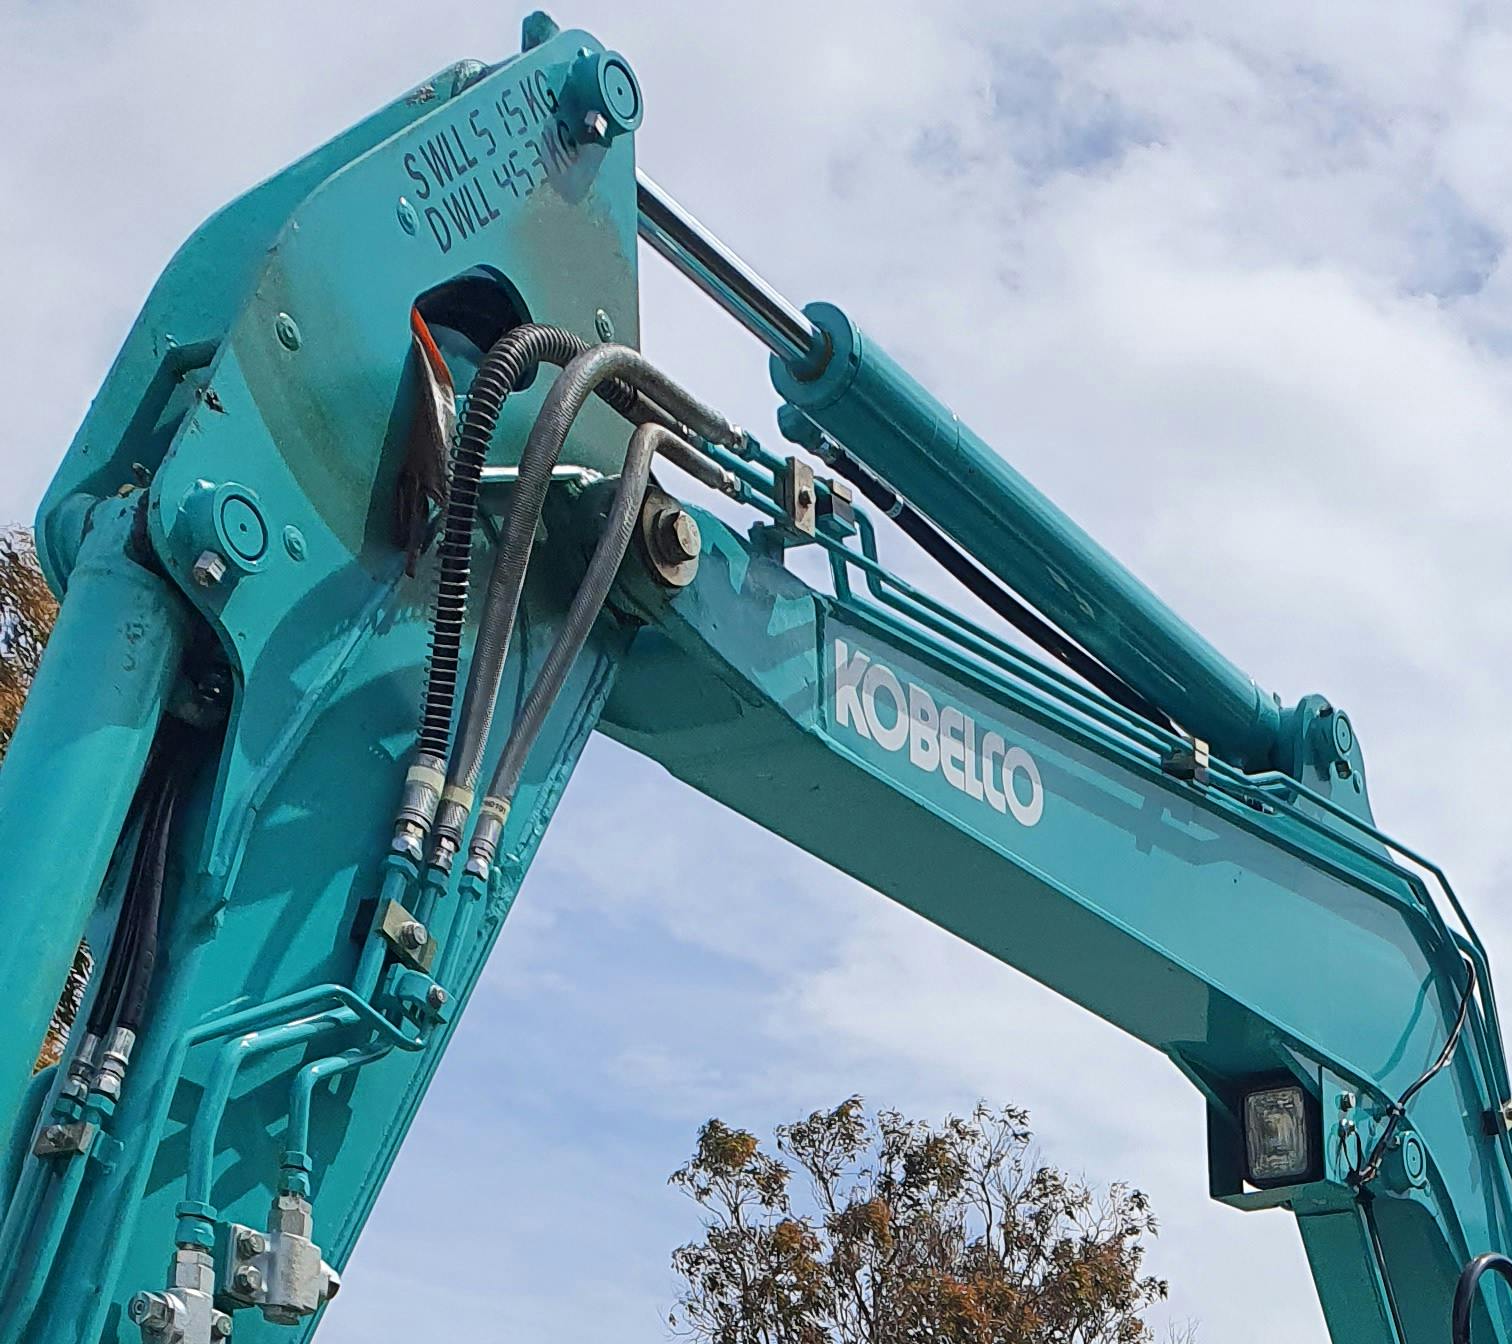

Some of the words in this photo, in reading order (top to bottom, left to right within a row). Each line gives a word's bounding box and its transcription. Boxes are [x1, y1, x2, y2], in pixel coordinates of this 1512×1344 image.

[404, 124, 478, 200] SWLL
[424, 176, 501, 254] DWLL
[834, 638, 1044, 827] KOBELCO
